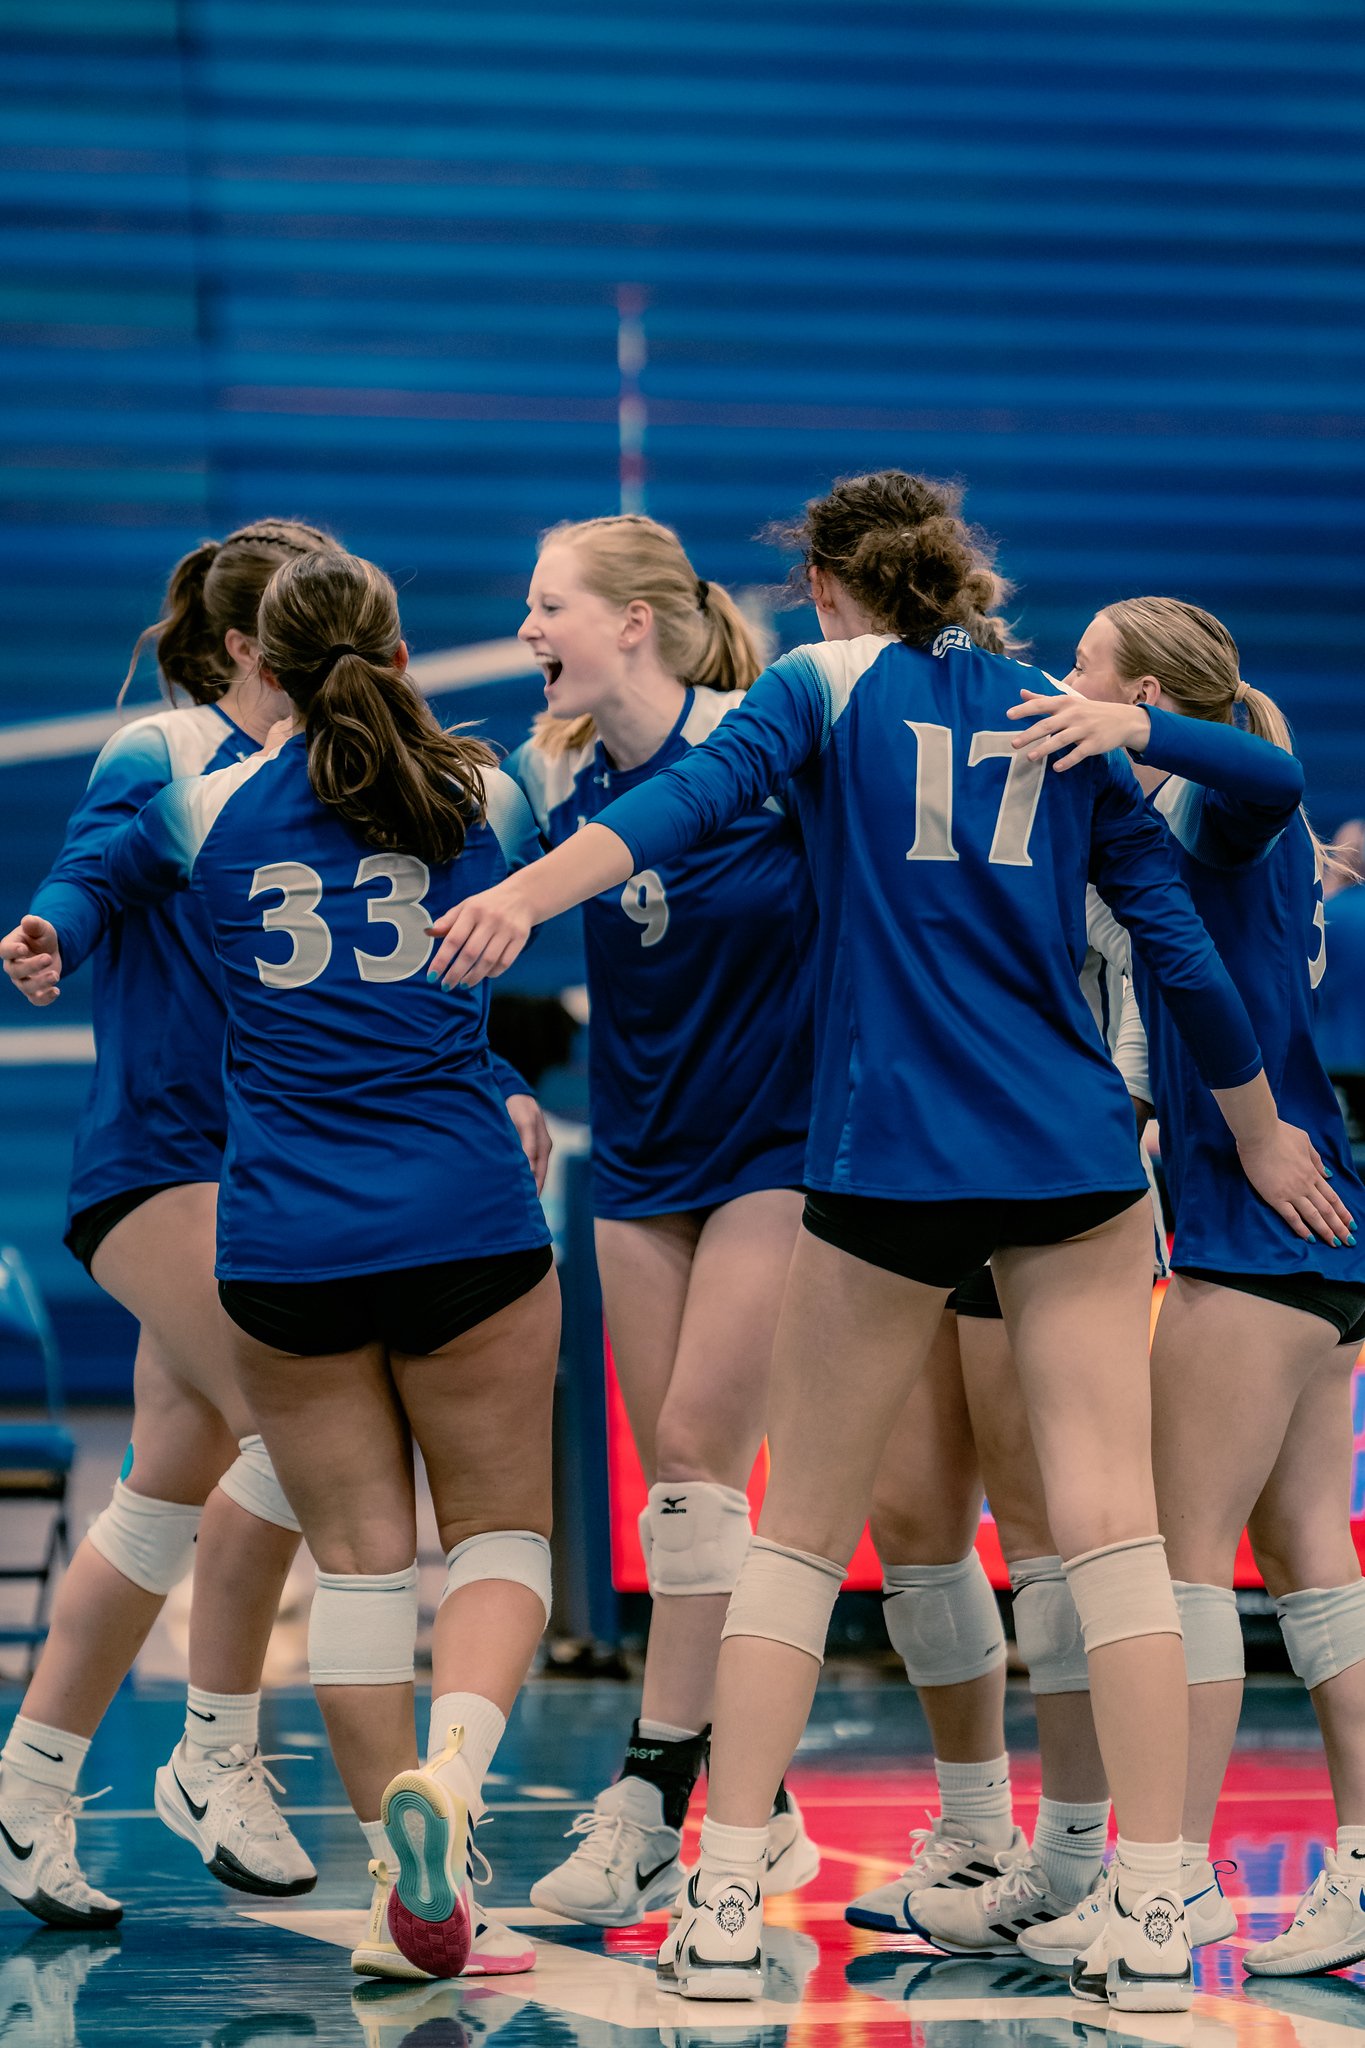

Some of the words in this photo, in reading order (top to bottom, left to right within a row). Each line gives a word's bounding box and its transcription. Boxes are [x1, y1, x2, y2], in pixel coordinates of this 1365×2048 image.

[903, 720, 1050, 866] 17
[248, 852, 434, 989] 33
[621, 869, 669, 947] 9
